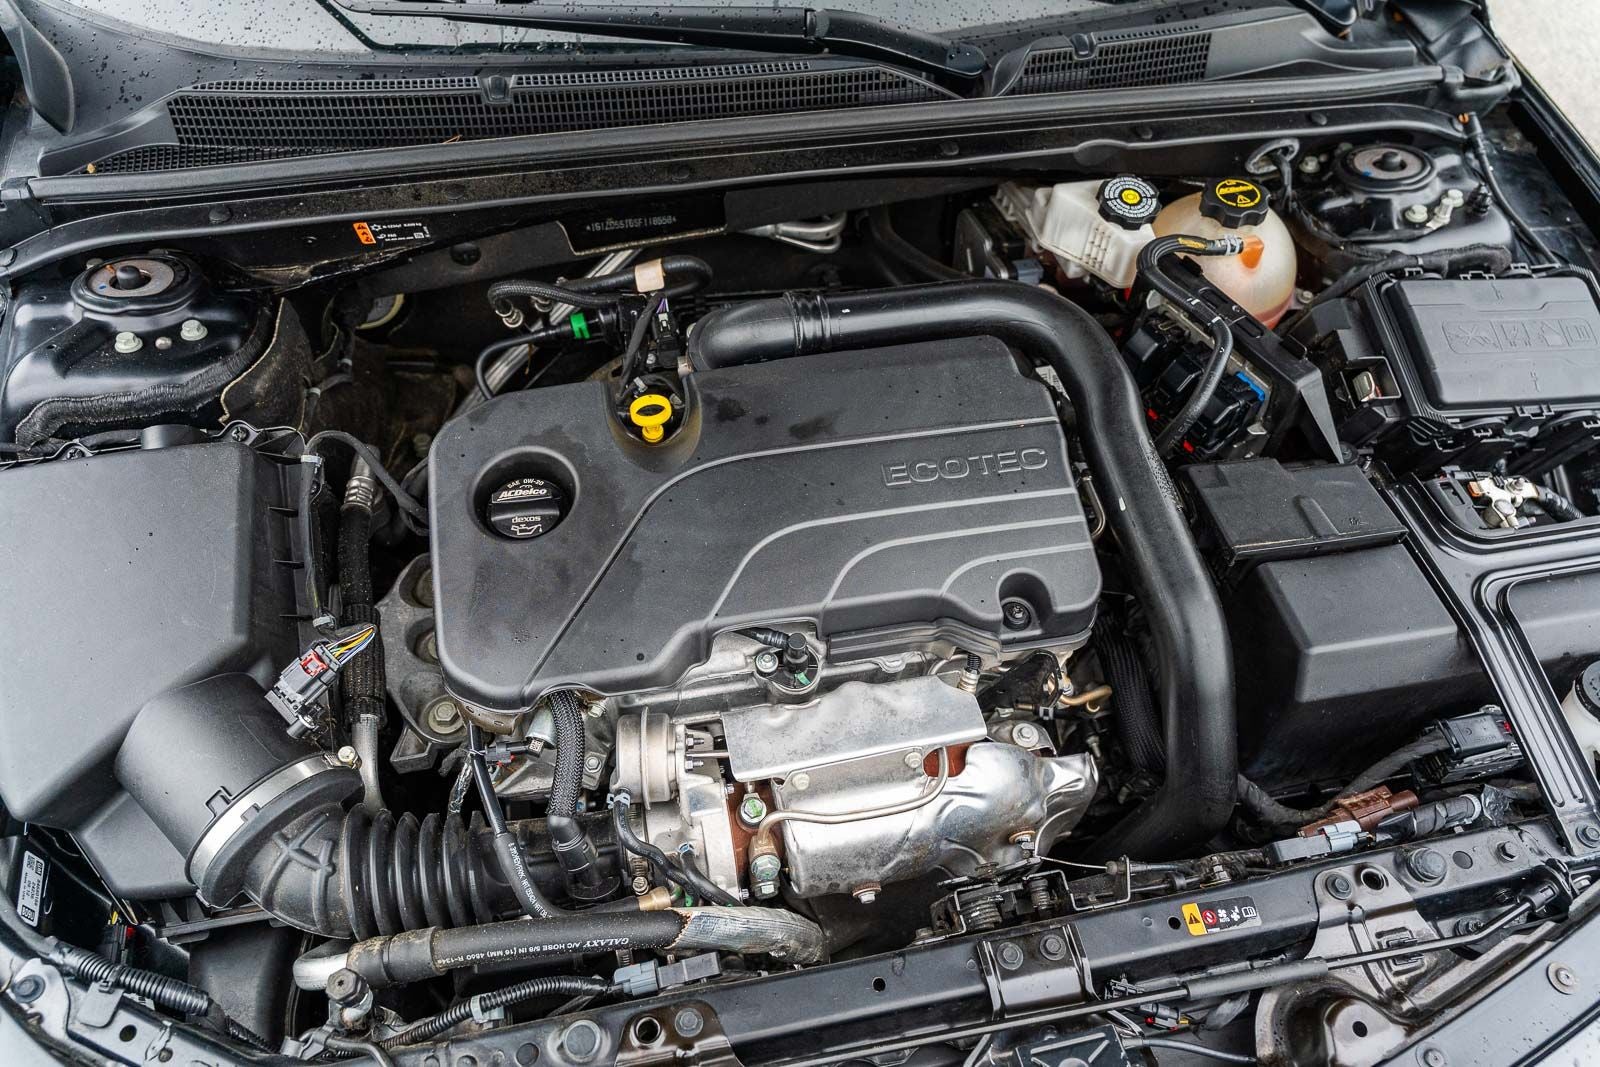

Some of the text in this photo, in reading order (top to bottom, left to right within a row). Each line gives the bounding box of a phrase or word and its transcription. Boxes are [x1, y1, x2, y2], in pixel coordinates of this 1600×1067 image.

[881, 448, 1049, 487] ECOTEC
[507, 478, 545, 489] SAE 0W-20
[497, 488, 547, 500] ACDelco
[511, 516, 541, 524] dexos
[542, 943, 565, 951] HOSE
[583, 937, 629, 948] GALAXY
[486, 950, 503, 958] MM)
